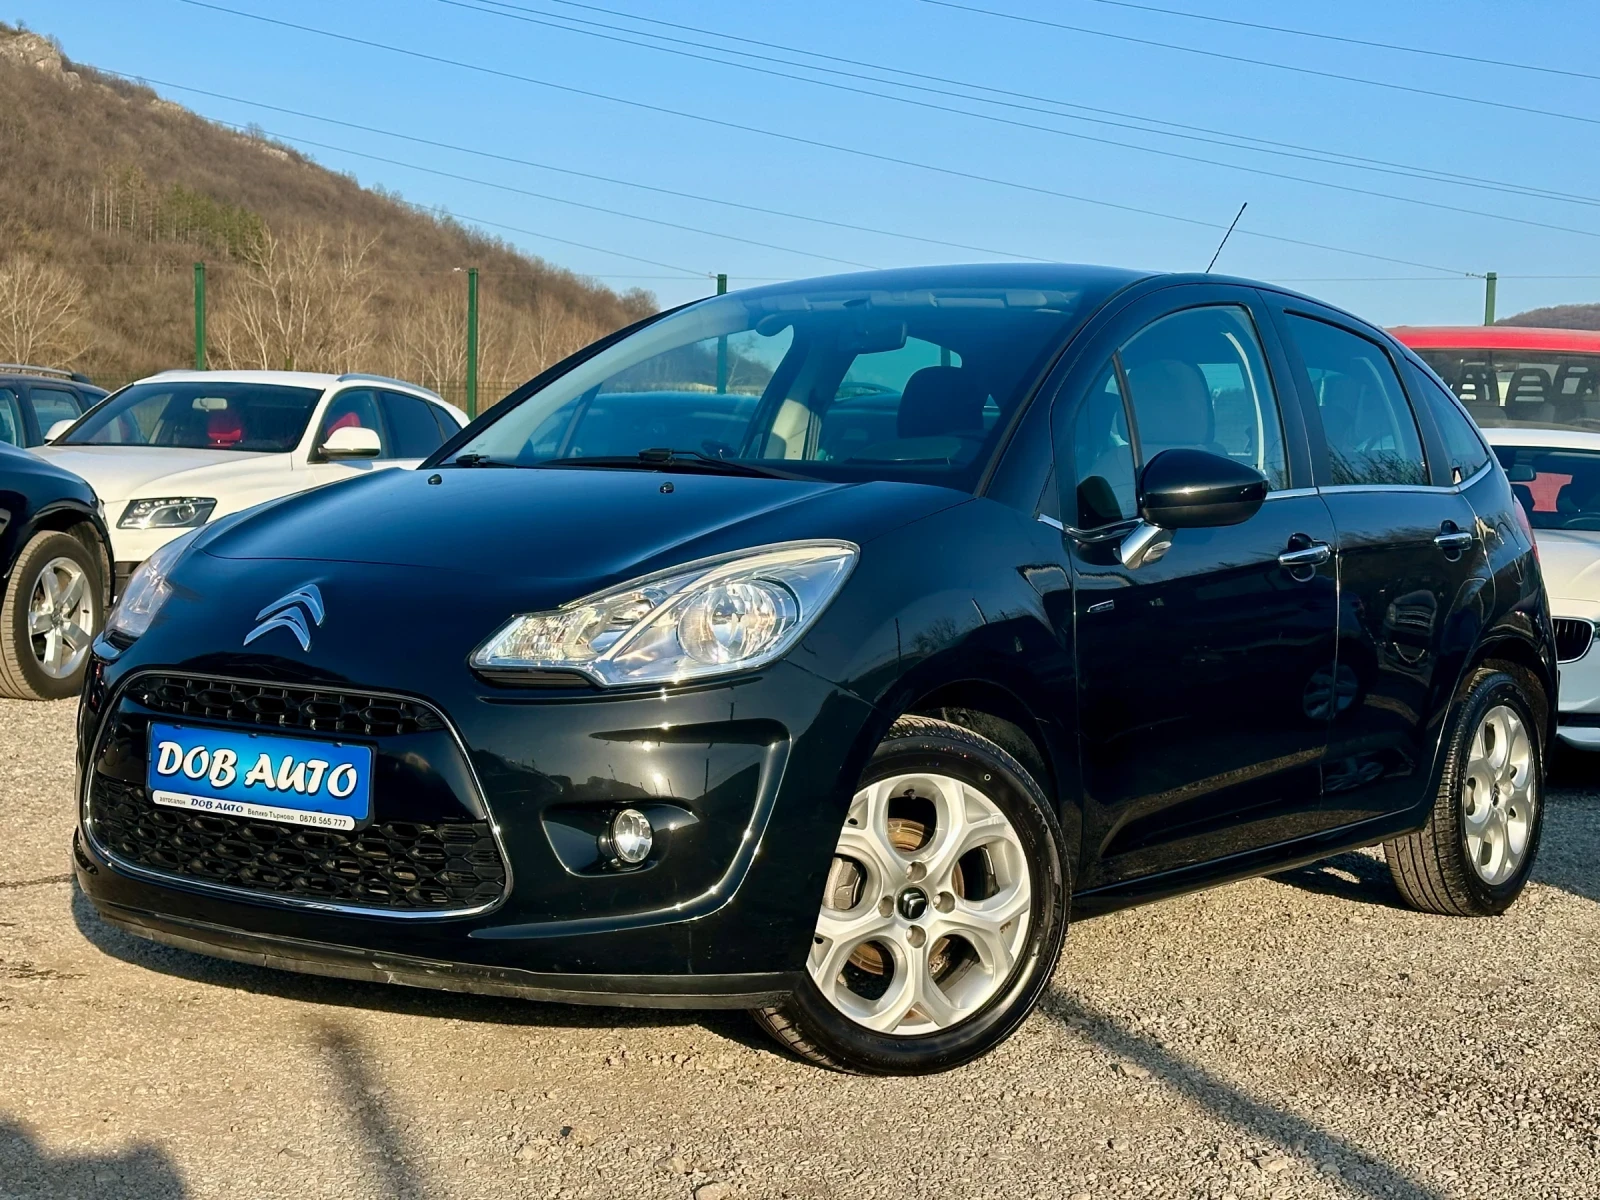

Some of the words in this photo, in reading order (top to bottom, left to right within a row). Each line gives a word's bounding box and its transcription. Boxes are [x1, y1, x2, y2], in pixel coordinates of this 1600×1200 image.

[157, 741, 237, 788] DOB
[244, 753, 358, 798] AUTO
[159, 796, 186, 805] автосалон
[190, 798, 213, 809] DOB
[215, 802, 244, 813] AUTO
[247, 808, 269, 817] Велико
[269, 811, 295, 820] Търново
[318, 816, 332, 826] 565
[333, 818, 347, 827] 777
